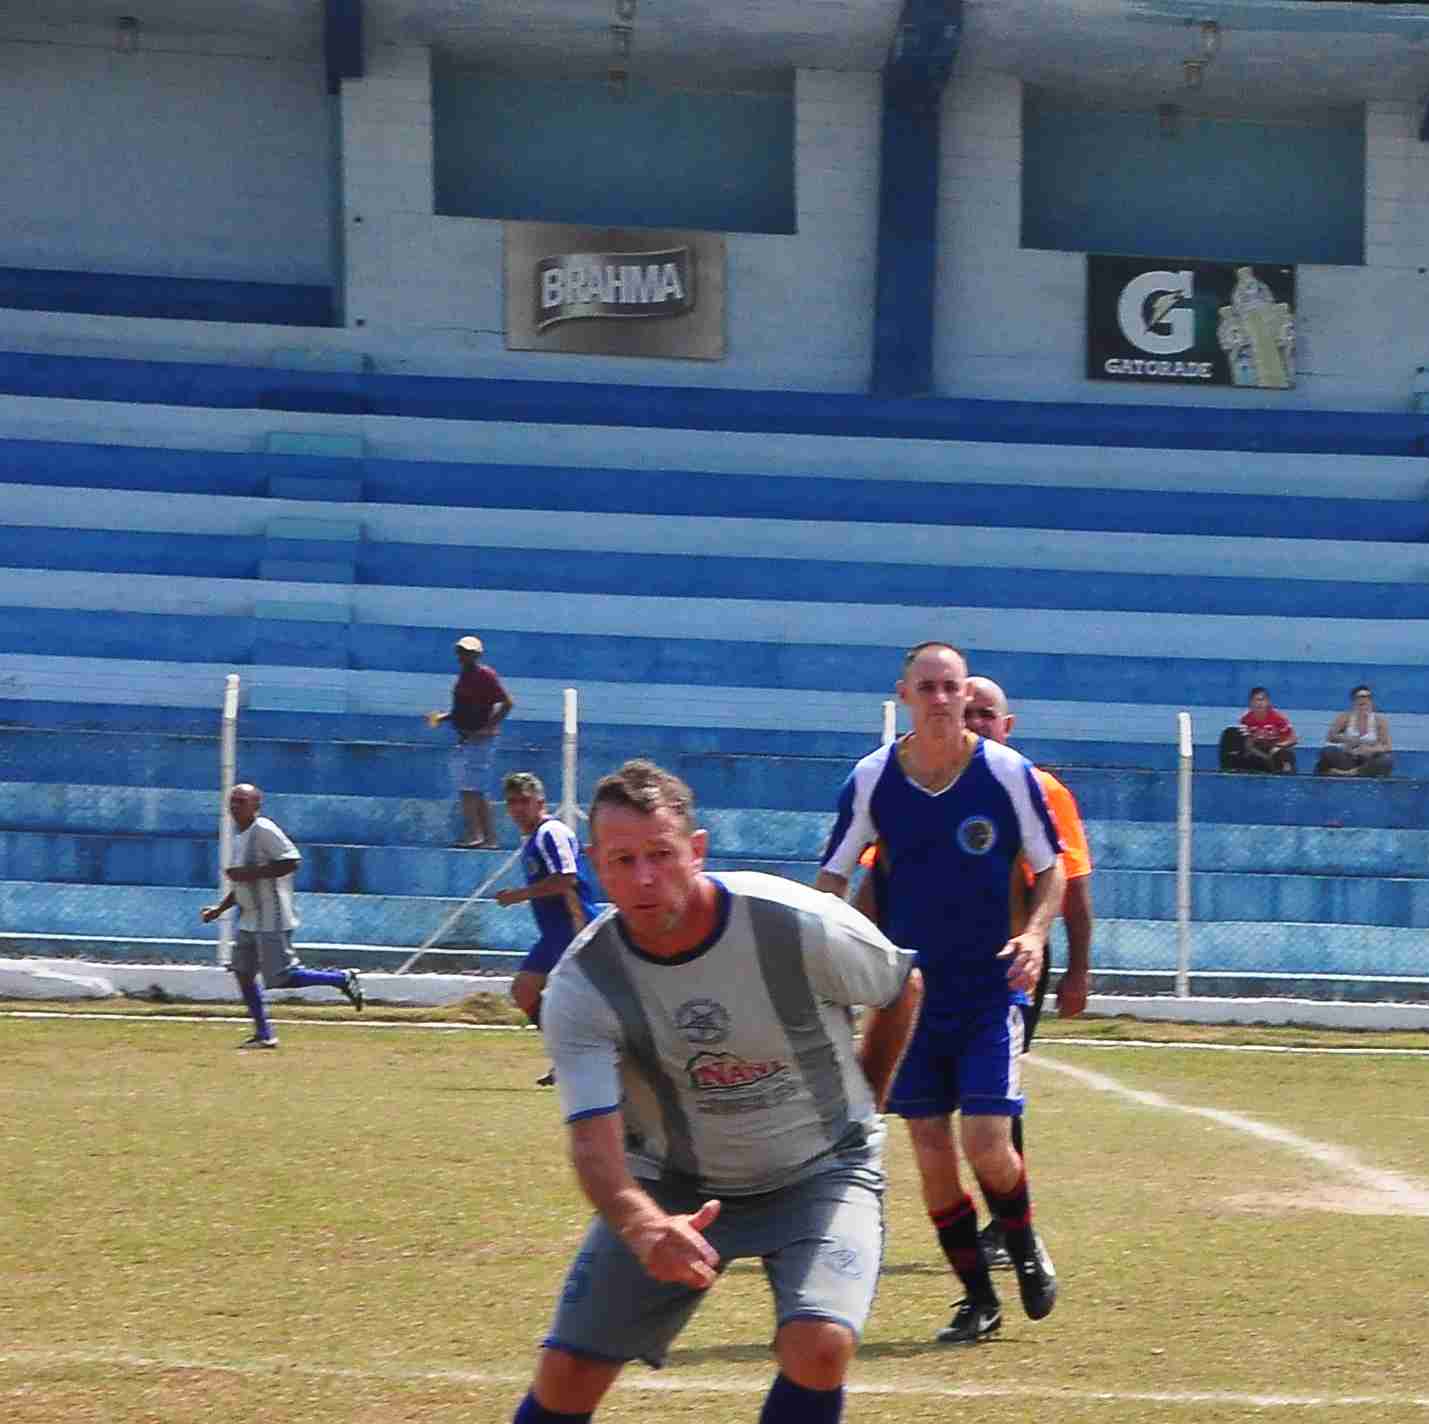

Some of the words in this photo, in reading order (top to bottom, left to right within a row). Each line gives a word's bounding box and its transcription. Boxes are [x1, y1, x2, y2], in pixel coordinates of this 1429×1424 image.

[542, 263, 684, 308] BRAHMA
[1117, 270, 1196, 355] G
[1104, 358, 1214, 378] GATORADE
